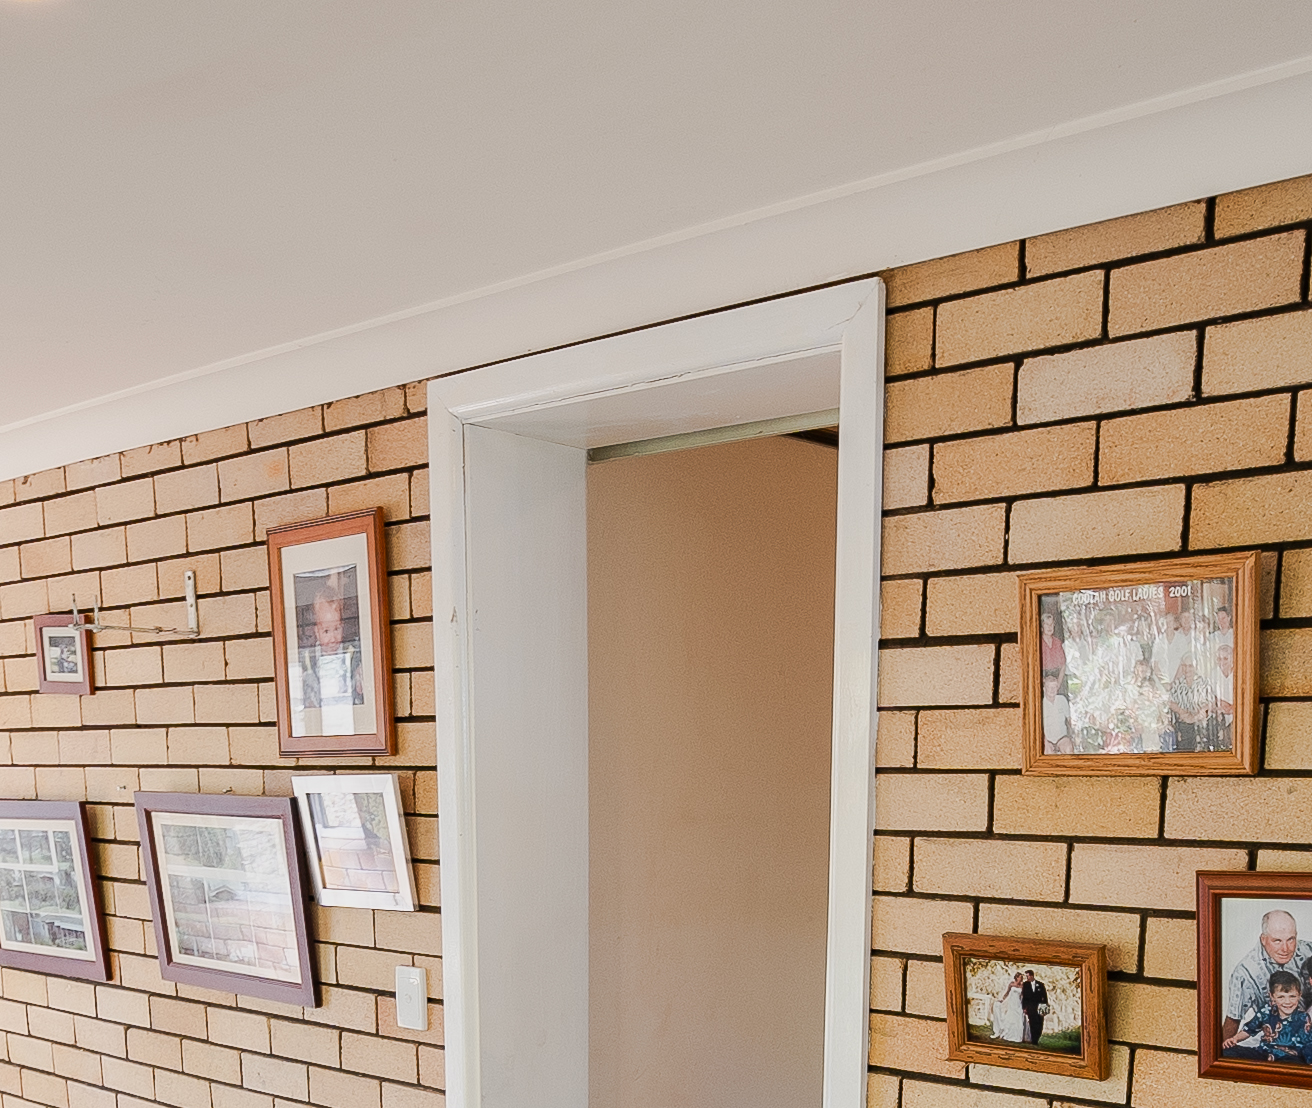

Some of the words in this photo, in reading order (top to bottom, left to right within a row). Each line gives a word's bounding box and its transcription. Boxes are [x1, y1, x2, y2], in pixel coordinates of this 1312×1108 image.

[1108, 589, 1130, 602] GOLF
[1133, 586, 1164, 601] LADIES
[1169, 585, 1192, 598] 2001
